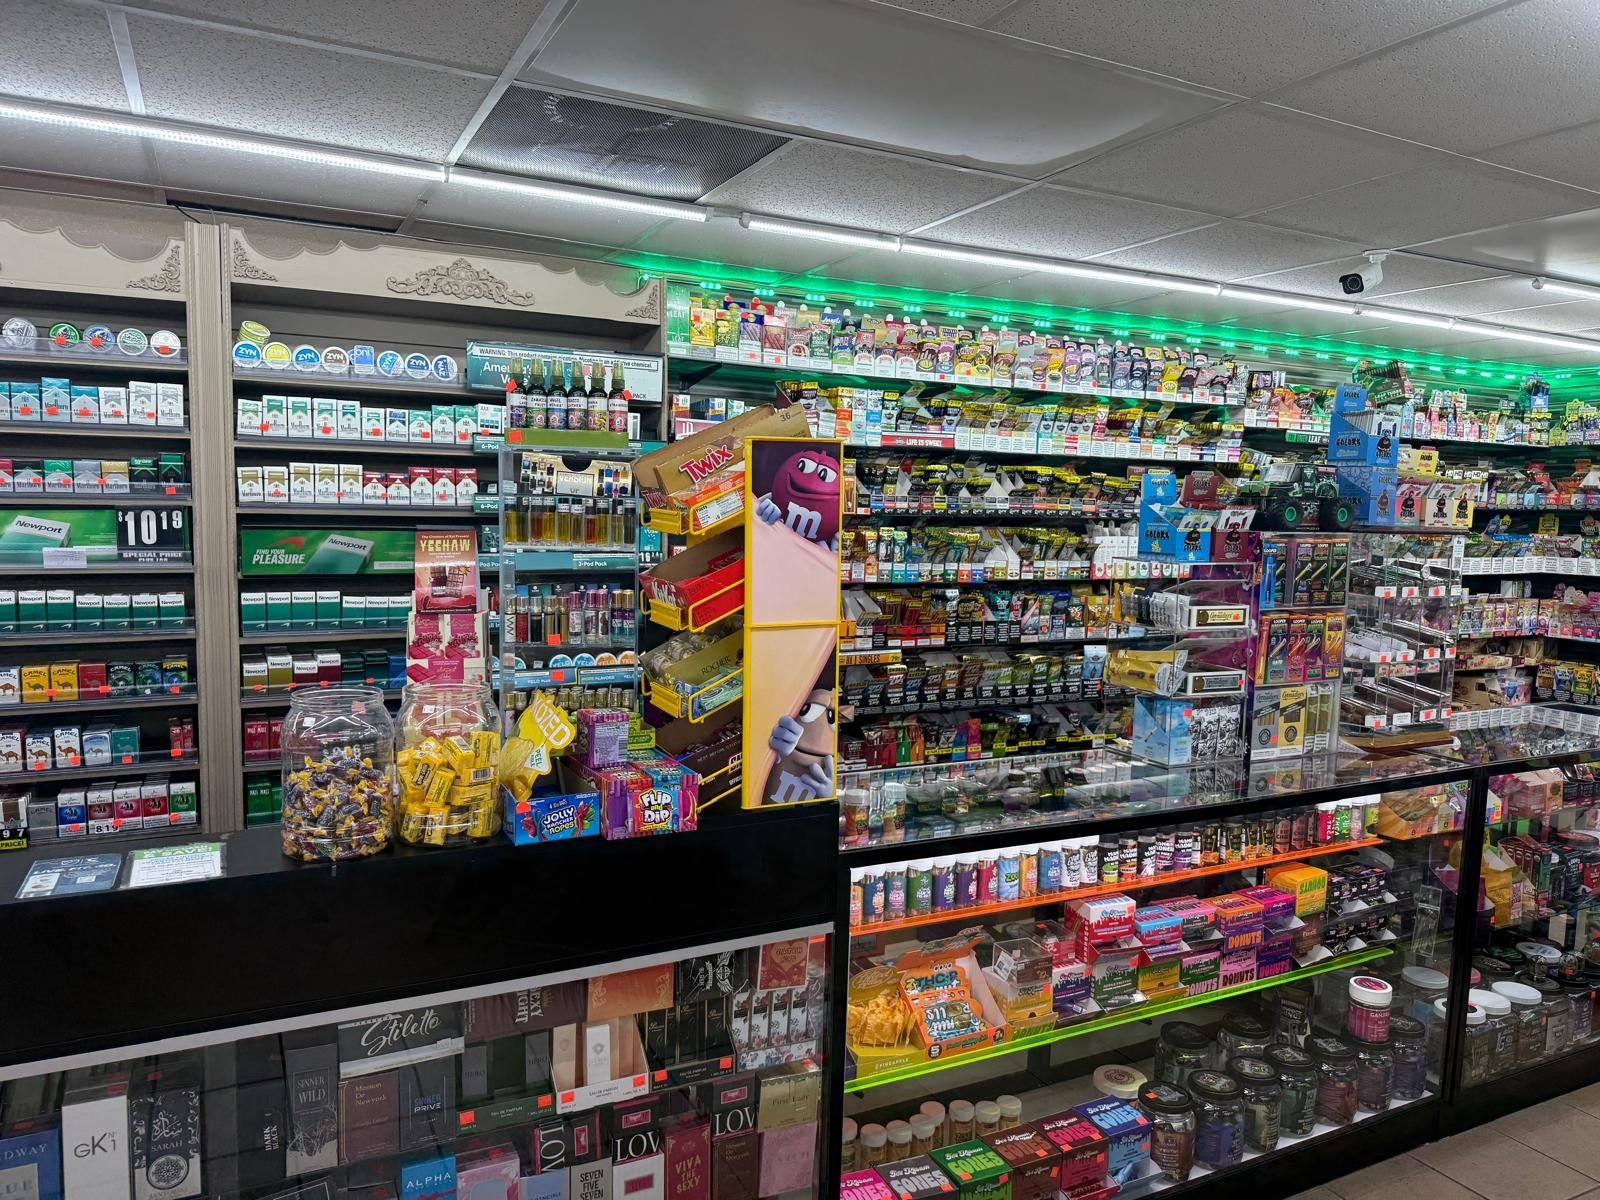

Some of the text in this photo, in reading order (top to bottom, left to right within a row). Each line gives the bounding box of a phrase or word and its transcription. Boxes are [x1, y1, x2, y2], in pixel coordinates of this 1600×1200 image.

[239, 348, 257, 356] ZYN
[410, 358, 426, 366] ZYN
[15, 519, 63, 534] Newport
[328, 537, 368, 552] Newport
[420, 540, 470, 552] YEEHAW
[252, 554, 305, 565] PLEASURE
[700, 656, 731, 676] ROCHER
[544, 807, 574, 824] JOLLY
[1228, 931, 1262, 948] DONUTS
[1223, 968, 1254, 986] DONUTS
[361, 1009, 440, 1056] Stiletto
[298, 1089, 326, 1103] WILD
[1092, 1105, 1142, 1129] CONES
[1046, 1121, 1100, 1145] CONES
[151, 1140, 183, 1152] SARAH
[947, 1152, 1004, 1176] CONES
[406, 1172, 451, 1188] ALPHA
[580, 1170, 603, 1182] SEVEN
[890, 1170, 950, 1194] CONES
[583, 1181, 599, 1192] FIVE
[676, 1176, 700, 1193] SEXY
